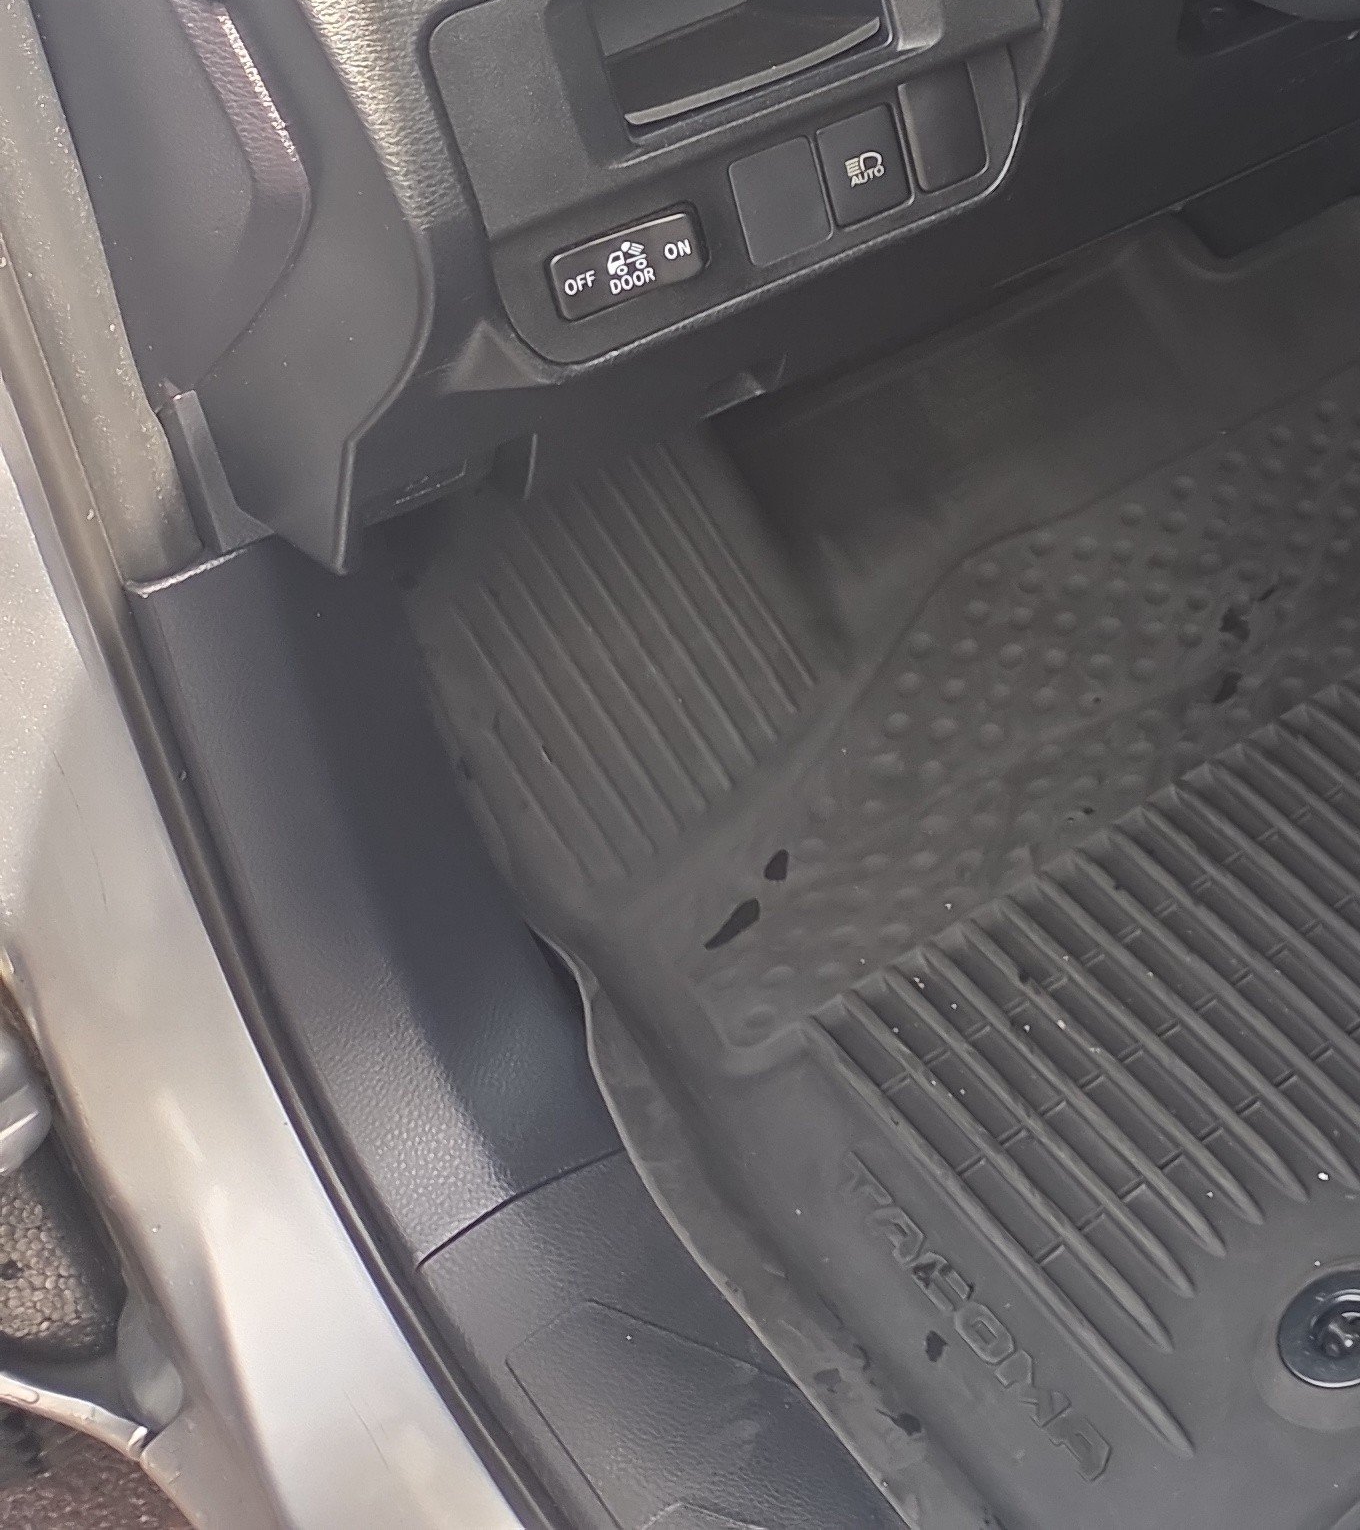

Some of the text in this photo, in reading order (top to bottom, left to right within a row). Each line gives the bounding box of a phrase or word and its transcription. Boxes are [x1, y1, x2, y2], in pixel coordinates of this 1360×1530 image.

[850, 164, 886, 189] AUTO
[664, 238, 692, 262] ON
[564, 270, 596, 297] OFF
[608, 268, 657, 296] DOOR
[847, 1149, 1114, 1484] TACOMA
